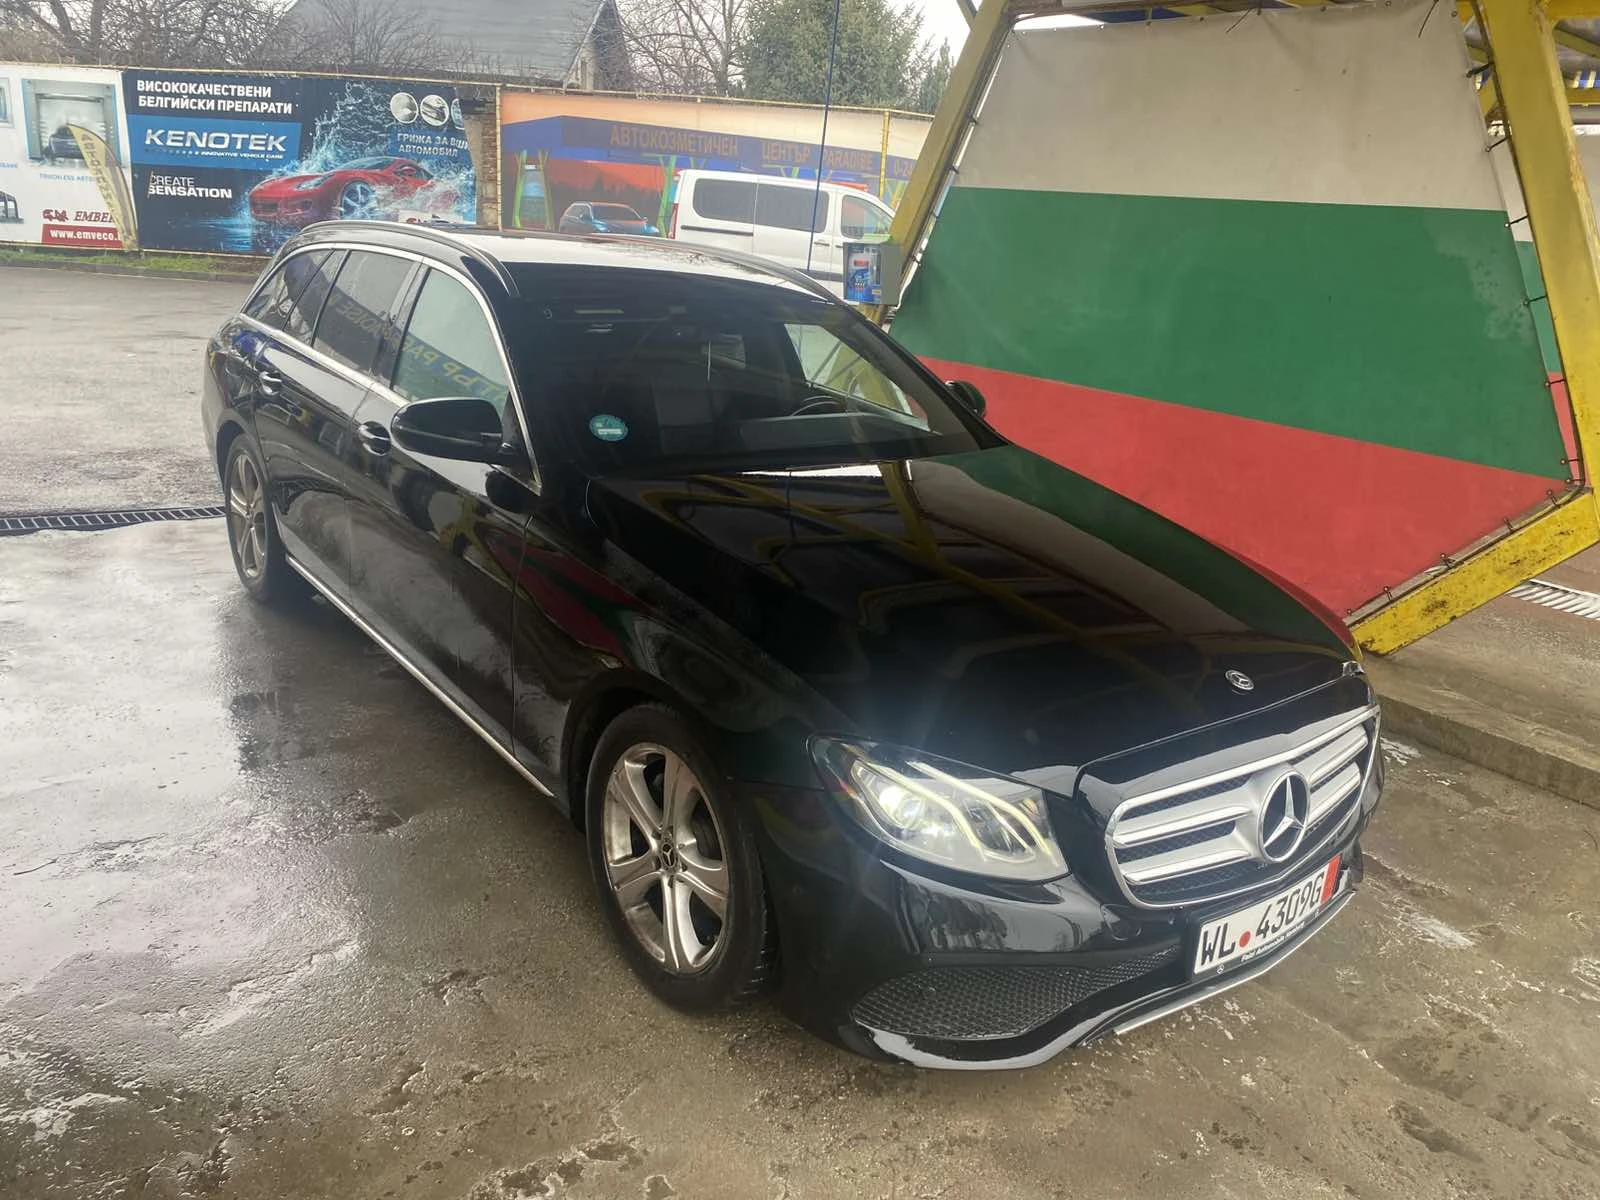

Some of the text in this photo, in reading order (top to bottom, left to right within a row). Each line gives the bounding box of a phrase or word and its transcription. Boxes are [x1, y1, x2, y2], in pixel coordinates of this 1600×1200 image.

[136, 80, 272, 98] ВИСОКОКАЧЕСТВЕНИ
[138, 95, 293, 115] БЕЛГИЙСКИ ПРЕПАРАТИ
[145, 129, 287, 152] KENOTEK
[397, 133, 432, 145] ГРИЖА
[435, 135, 449, 145] ЗА
[610, 125, 739, 157] АВТОКОЗМЕТИЧЕН
[762, 141, 811, 163] ЦЕНТЪР
[823, 148, 873, 171] PARADISE
[398, 143, 458, 157] АВТОМОБИЛ
[150, 175, 195, 187] CREATE
[148, 185, 232, 198] SENSATION
[1201, 922, 1236, 966] WL
